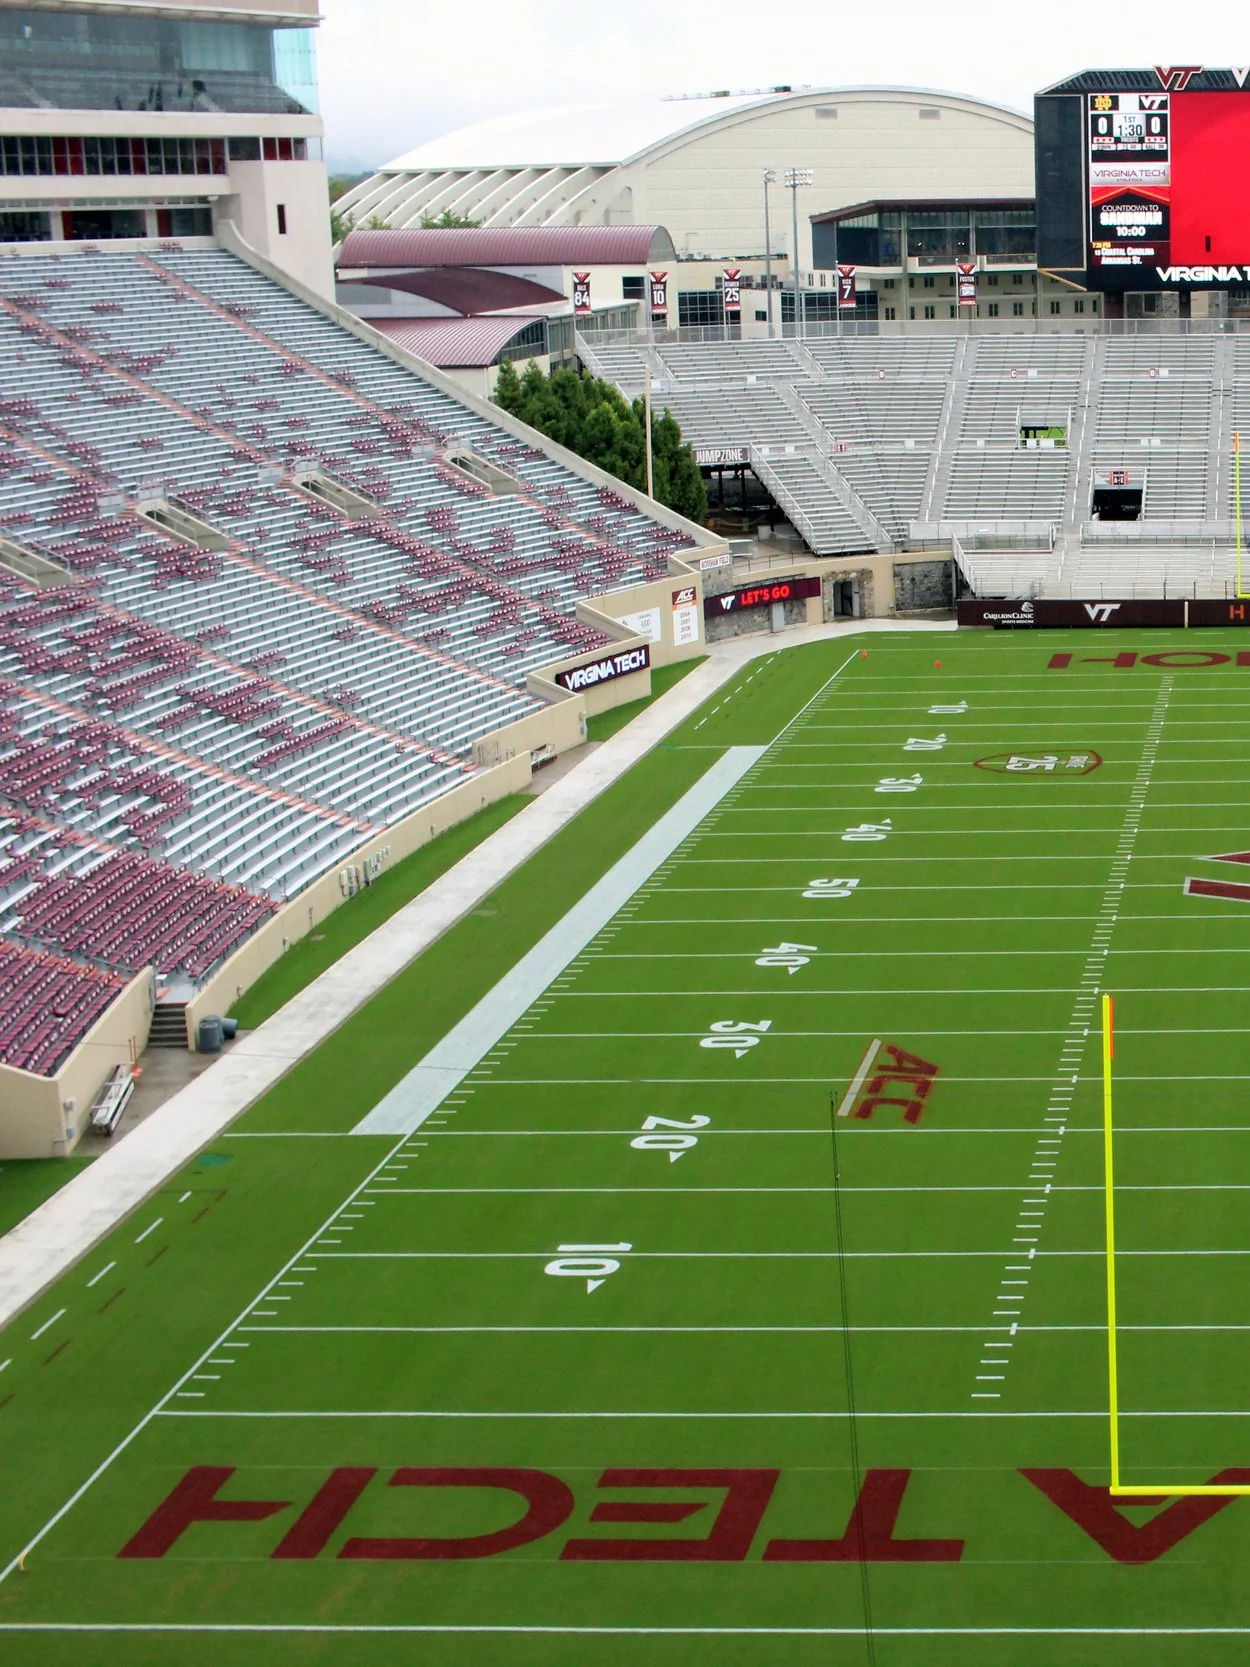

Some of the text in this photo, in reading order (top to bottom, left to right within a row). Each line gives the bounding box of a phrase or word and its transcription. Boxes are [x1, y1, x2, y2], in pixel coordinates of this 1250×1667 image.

[1154, 66, 1204, 90] VT
[1140, 96, 1167, 110] VT
[1098, 117, 1107, 135] 0
[1118, 125, 1143, 136] 1:30
[1151, 117, 1160, 135] 0
[1100, 211, 1162, 226] SANDMAN
[1116, 226, 1146, 237] 10:00
[1156, 266, 1242, 282] VIRGINIA
[575, 291, 590, 306] 84
[653, 291, 664, 305] 10
[725, 288, 739, 302] 25
[843, 285, 851, 299] 7
[676, 588, 694, 602] ACC
[721, 585, 790, 610] VT LET'S GO
[1083, 603, 1122, 621] VT
[565, 649, 646, 690] VIRGINIA TECH
[1005, 755, 1059, 772] 25
[841, 823, 892, 841] 40
[802, 878, 860, 898] 50
[755, 942, 818, 966] 40
[700, 1020, 772, 1048] 30
[852, 1042, 940, 1126] ACC
[630, 1115, 711, 1150] 20
[544, 1242, 633, 1276] 10
[115, 1465, 966, 1563] TECH
